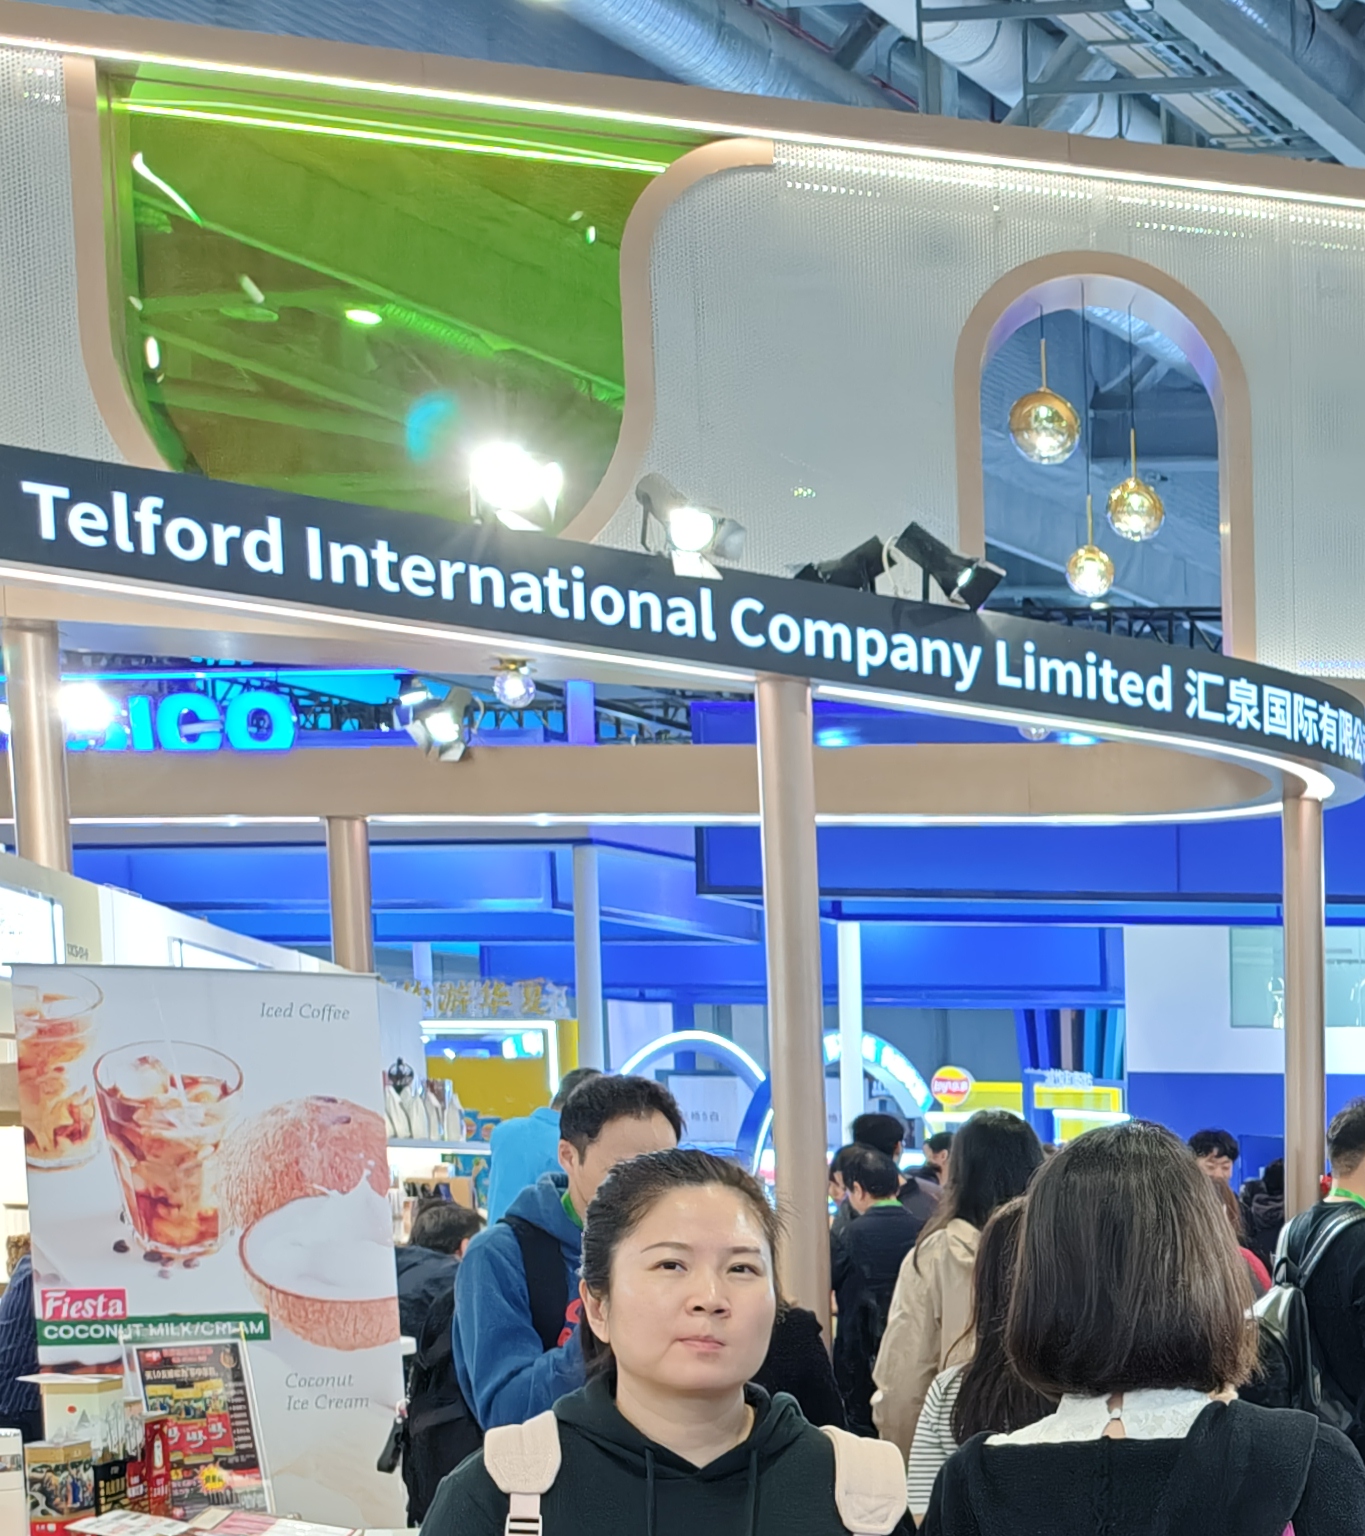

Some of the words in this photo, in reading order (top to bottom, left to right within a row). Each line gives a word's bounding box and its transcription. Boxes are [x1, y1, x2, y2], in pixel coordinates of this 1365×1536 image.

[21, 480, 284, 575] Telford
[306, 526, 716, 643] International
[730, 597, 982, 692] Company
[995, 637, 1172, 713] Limited
[260, 1002, 293, 1020] Iced
[299, 1002, 350, 1023] Coffee
[42, 1290, 126, 1320] Fiesta
[43, 1323, 144, 1341] COCONUT
[285, 1372, 355, 1389] Coconut
[286, 1396, 309, 1412] Ice
[314, 1395, 370, 1411] Cream
